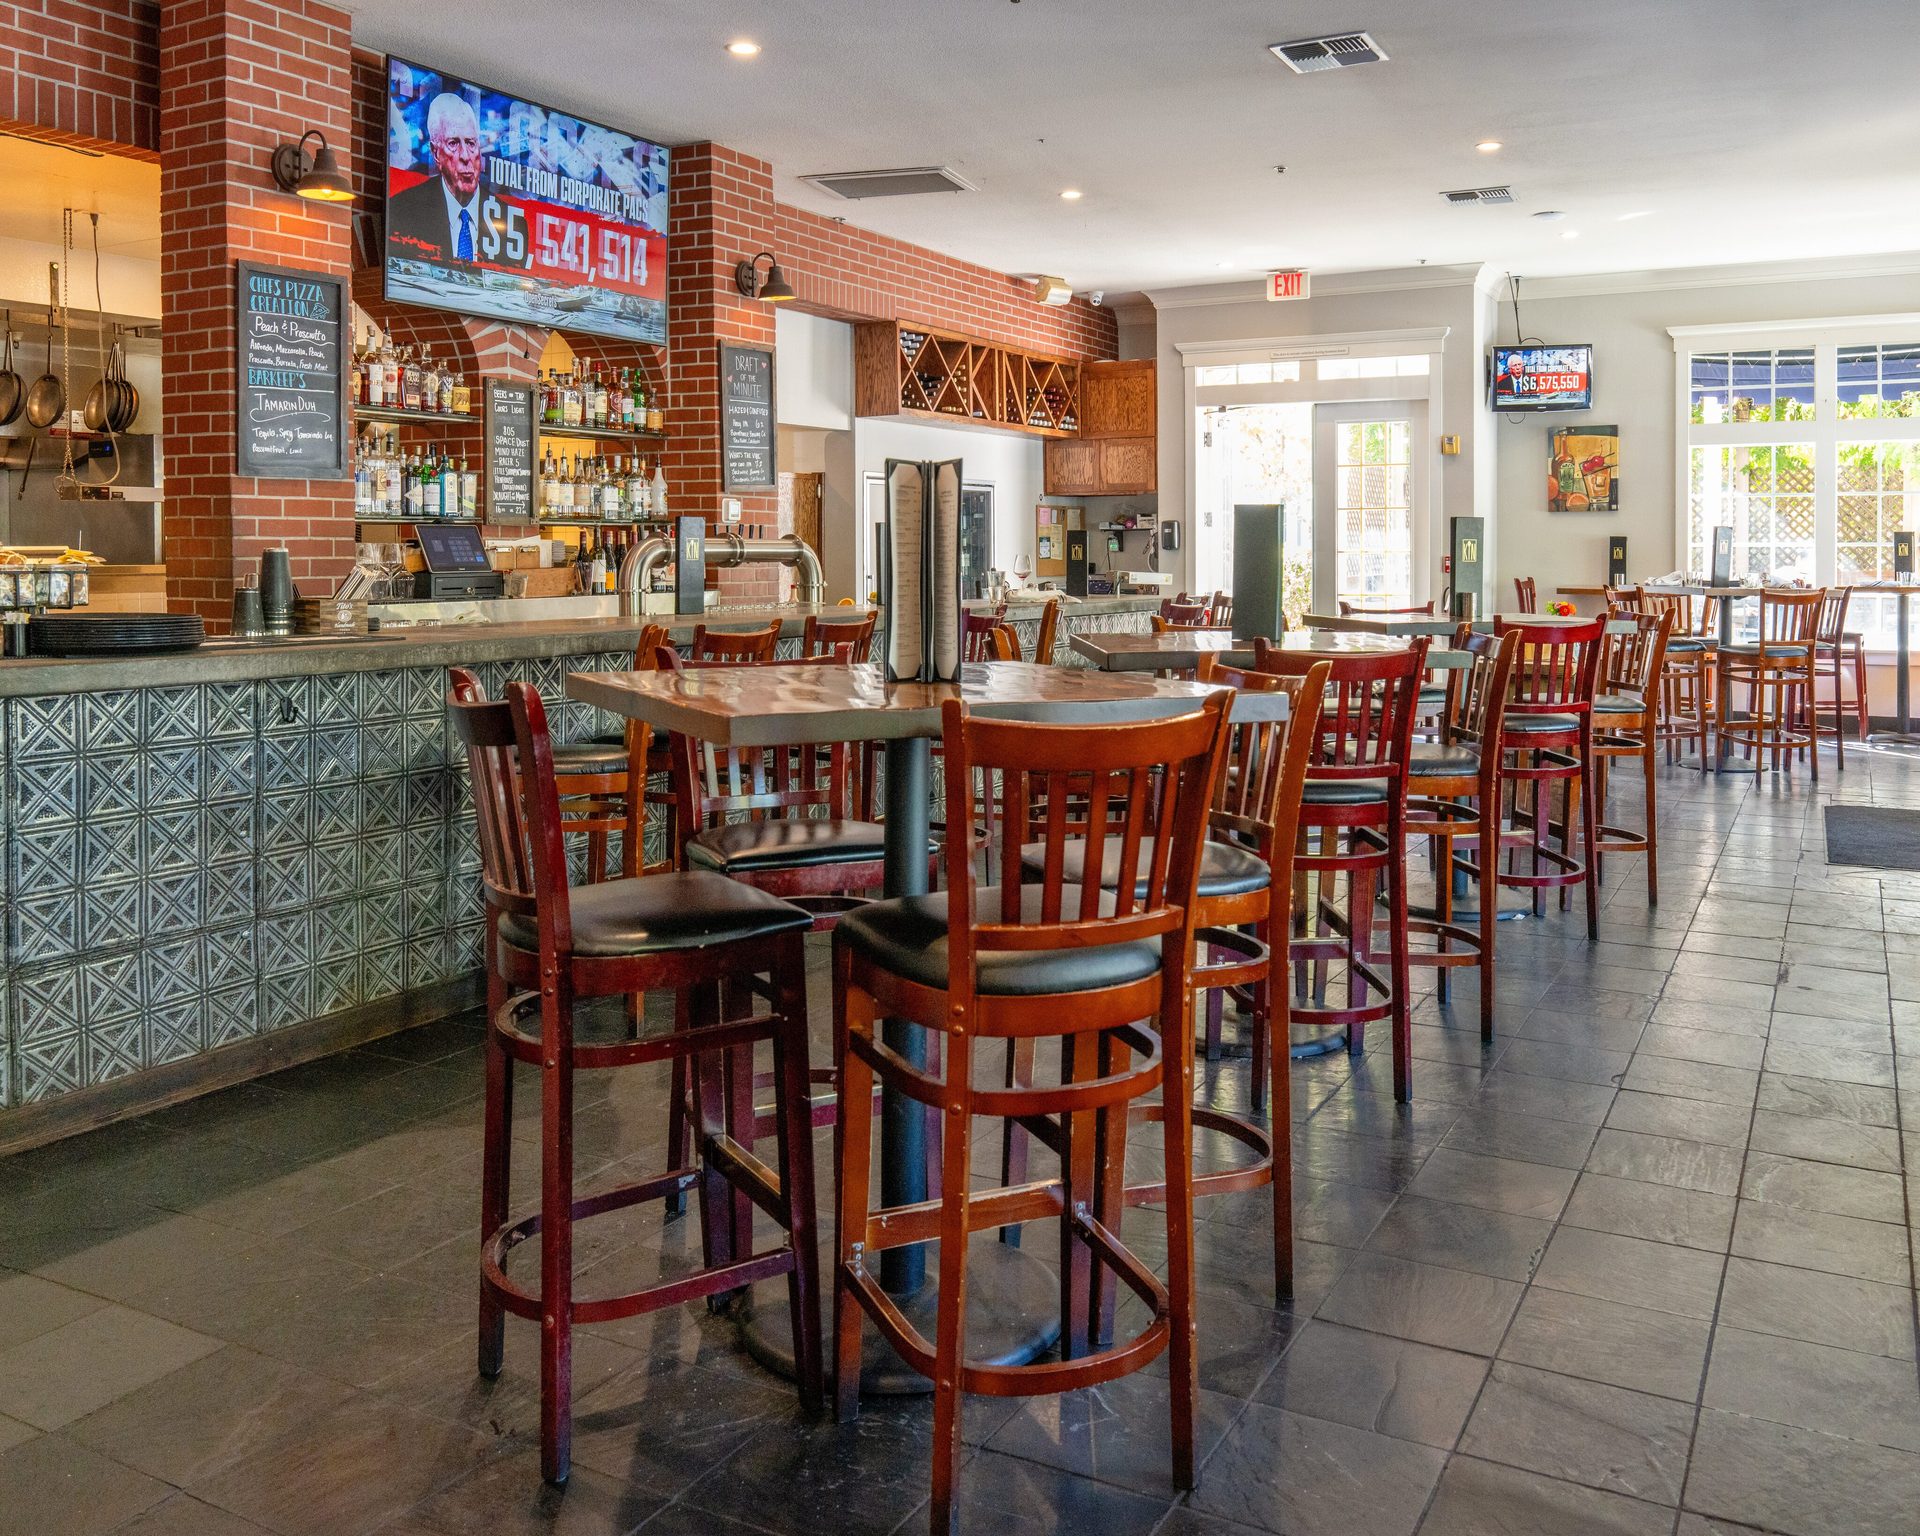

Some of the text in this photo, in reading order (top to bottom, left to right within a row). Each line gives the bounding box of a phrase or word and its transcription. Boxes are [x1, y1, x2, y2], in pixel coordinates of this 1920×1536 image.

[489, 156, 648, 223] TOTAL FROM CORPORATE PACS
[249, 276, 325, 302] CHEFS PIZZA
[1275, 274, 1302, 296] EXIT
[250, 294, 309, 317] CREATION
[255, 316, 279, 333] Peach
[290, 321, 326, 341] Prosciutto
[299, 358, 313, 370] Fresh
[735, 355, 759, 373] DRAFT
[248, 368, 306, 389] BARKEEP'S
[740, 373, 757, 383] OF THE
[1523, 375, 1580, 391] $6,575,550
[494, 389, 507, 399] BEERS
[733, 382, 762, 399] MINUTE
[503, 425, 516, 437] 805
[495, 435, 530, 448] SPACE DUST
[494, 447, 525, 457] MIND HAZE
[515, 458, 520, 468] 5
